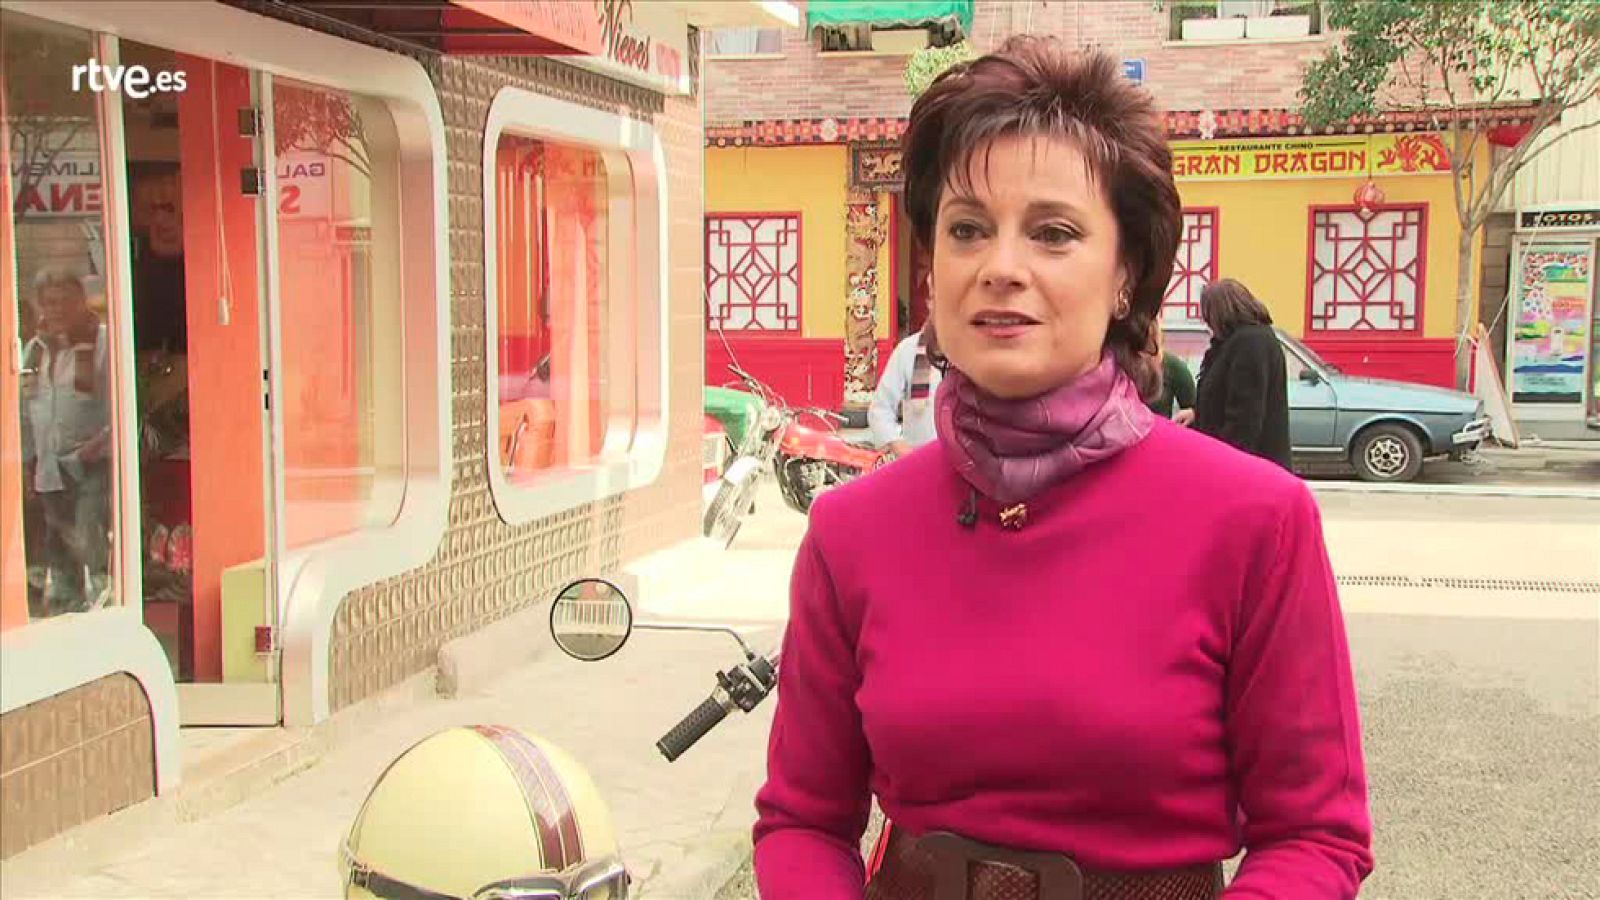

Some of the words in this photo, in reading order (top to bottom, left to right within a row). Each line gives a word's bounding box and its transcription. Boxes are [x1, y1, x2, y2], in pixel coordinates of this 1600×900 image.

[594, 0, 651, 73] Nieves
[1218, 143, 1283, 152] RESTAURANTE
[1284, 142, 1314, 150] CHINO
[1173, 153, 1241, 176] GRAN
[1254, 150, 1366, 174] DRAGON
